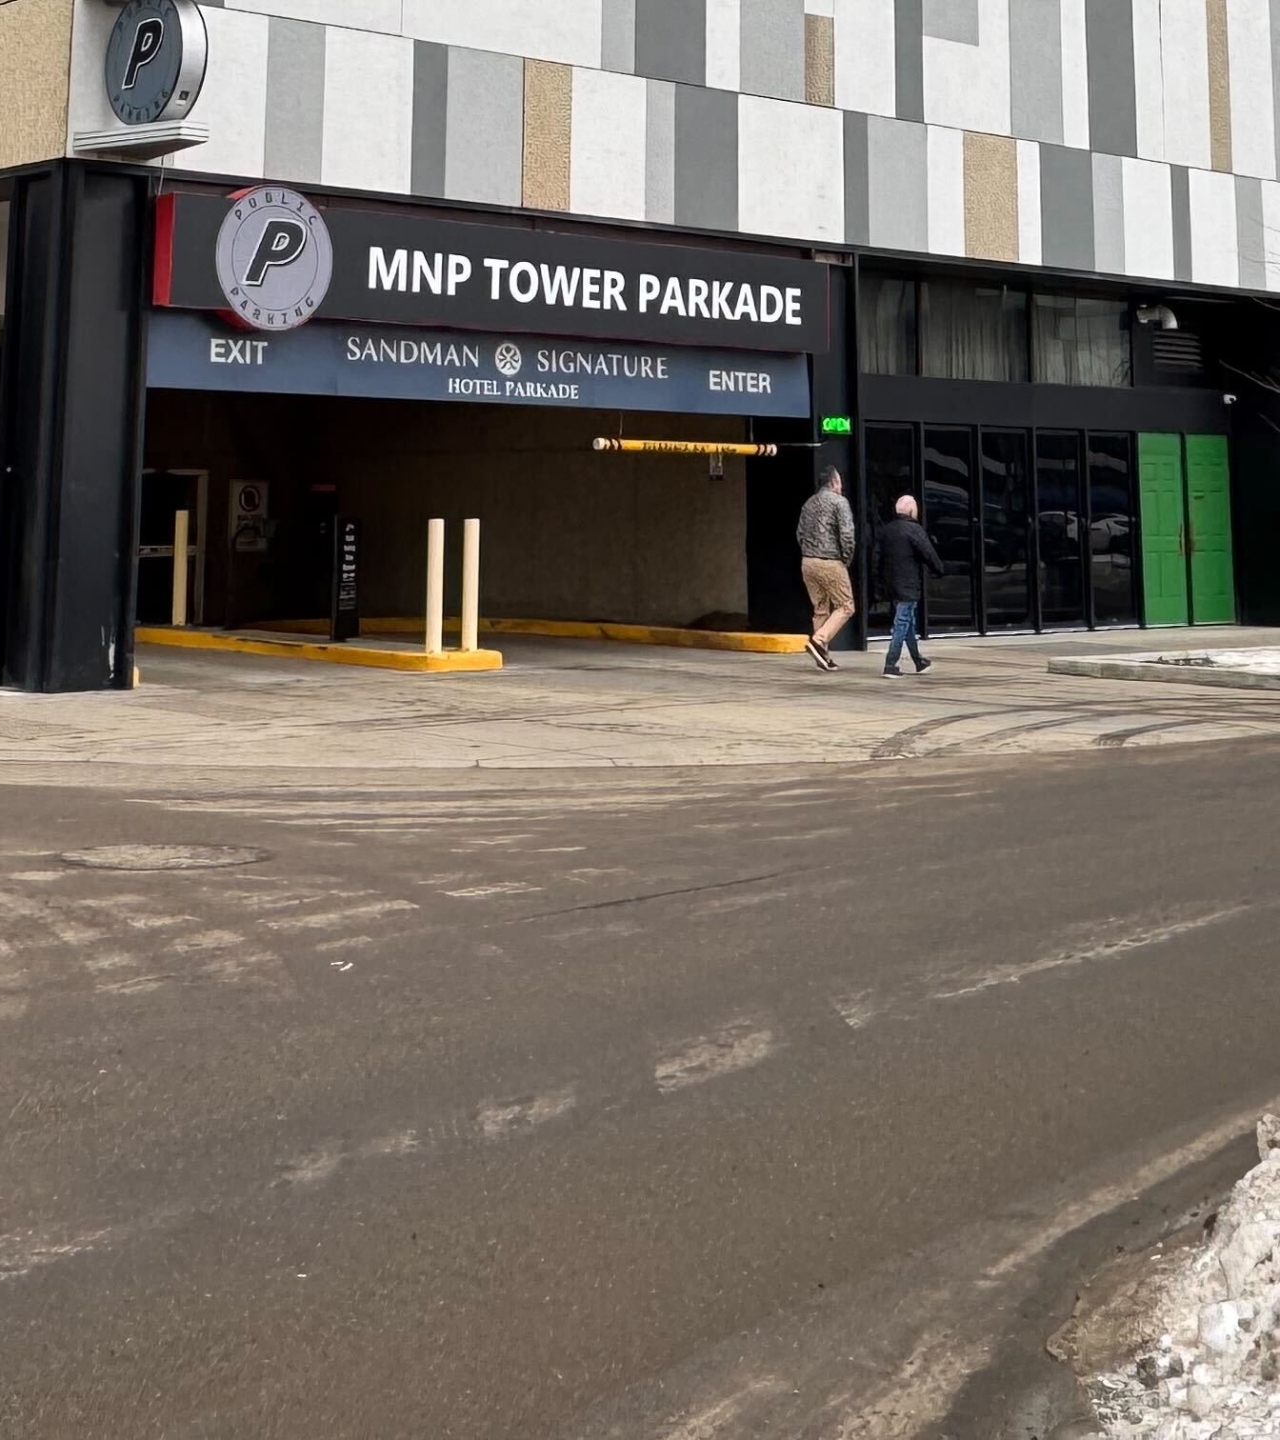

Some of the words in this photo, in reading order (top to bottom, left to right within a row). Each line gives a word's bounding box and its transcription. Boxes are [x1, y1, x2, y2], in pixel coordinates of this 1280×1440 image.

[122, 18, 165, 91] P
[241, 217, 308, 287] P
[367, 245, 472, 297] MNP
[483, 258, 628, 311] TOWER
[637, 273, 803, 326] PARKADE
[209, 338, 269, 366] EXIT
[346, 336, 480, 369] SANDMAN
[536, 348, 670, 380] SIGNATURE
[447, 377, 502, 396] HOTEL
[505, 380, 580, 400] PARKADE
[708, 369, 773, 395] ENTER
